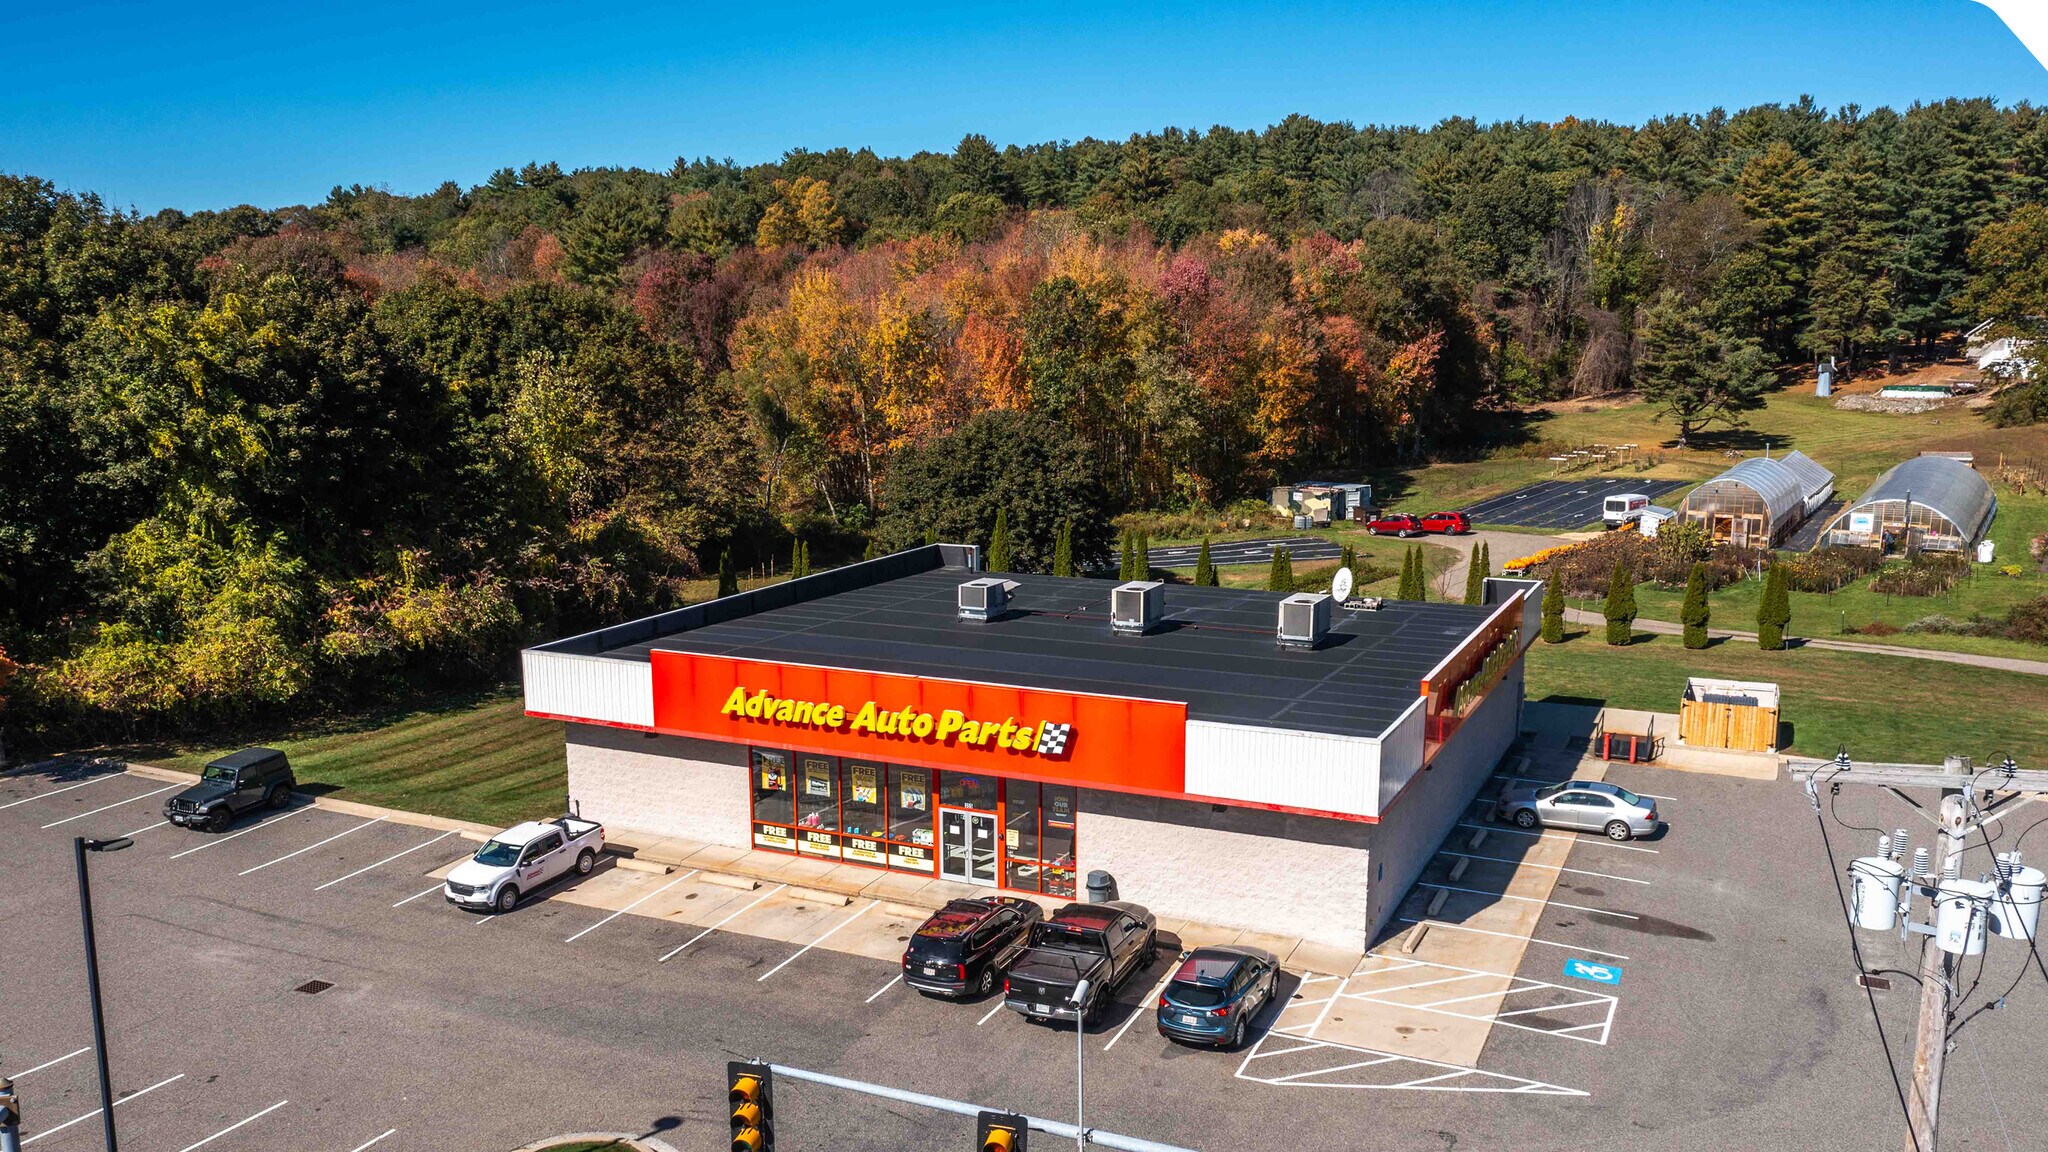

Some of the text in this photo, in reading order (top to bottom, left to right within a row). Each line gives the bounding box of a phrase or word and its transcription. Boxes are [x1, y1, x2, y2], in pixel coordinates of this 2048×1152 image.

[721, 686, 1034, 750] Advance Auto Parts
[806, 761, 829, 770] FREE
[852, 766, 876, 776] FREE
[902, 773, 925, 783] FREE
[1052, 806, 1071, 814] TEAM
[763, 825, 787, 837] FREE
[807, 831, 832, 844] FREE
[852, 838, 877, 851] FREE
[898, 845, 925, 858] FREE
